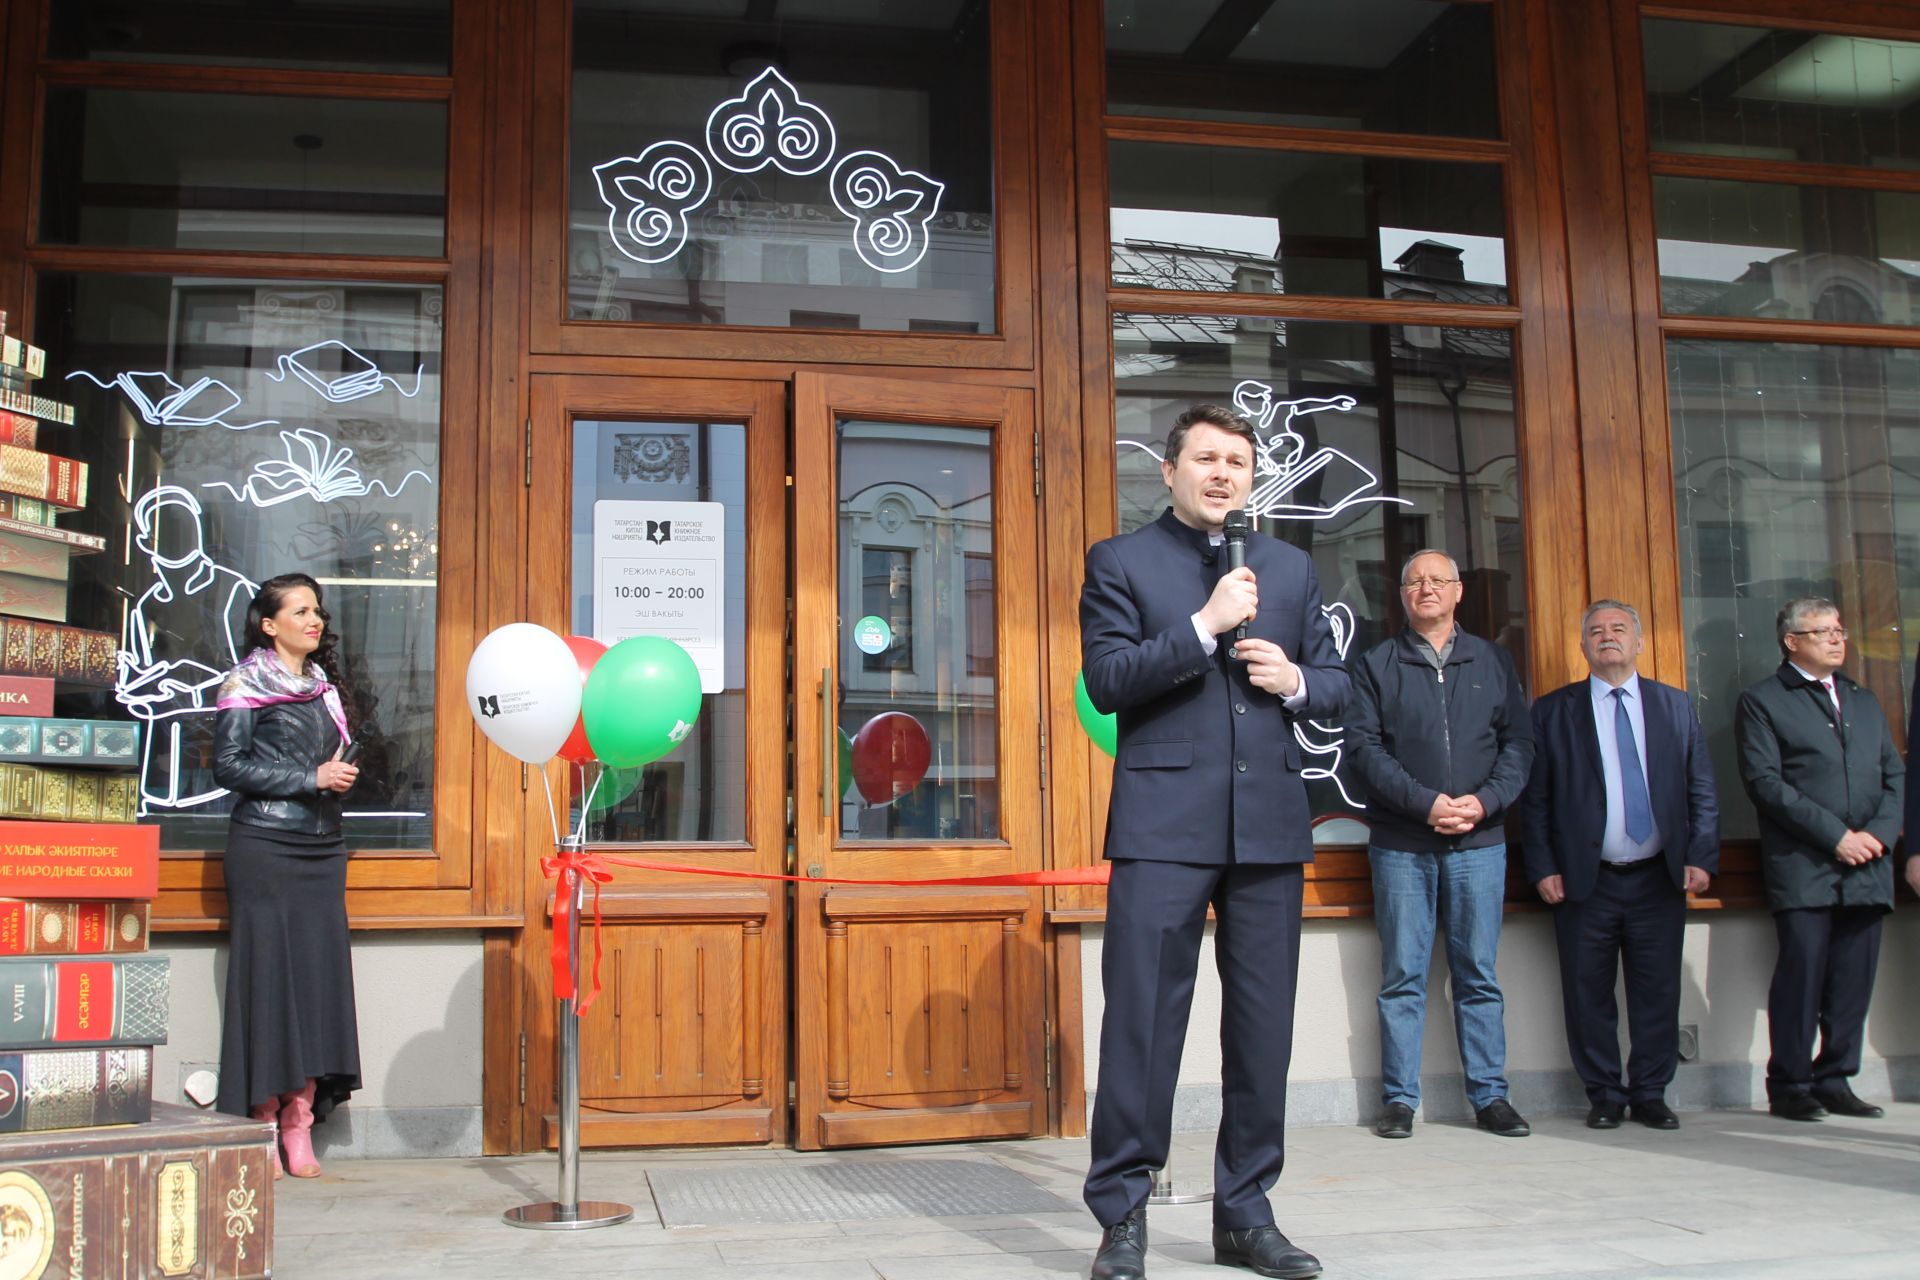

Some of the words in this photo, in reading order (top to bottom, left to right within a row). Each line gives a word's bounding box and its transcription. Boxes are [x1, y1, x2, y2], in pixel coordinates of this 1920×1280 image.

[623, 567, 657, 576] РЕЖИМ
[660, 568, 696, 576] РАБОТЫ
[614, 586, 650, 598] 10:00
[667, 587, 704, 599] 20:00
[634, 610, 650, 618] ЭШ
[651, 610, 684, 618] ВАКЫТЫ
[4, 845, 46, 856] ХАЛЫК
[48, 845, 119, 857] ӘКИЯТЛӘРЕ
[15, 865, 87, 878] НАРОДНЫЕ
[89, 866, 133, 877] СКАЗКИ
[13, 984, 25, 1023] V-VIII
